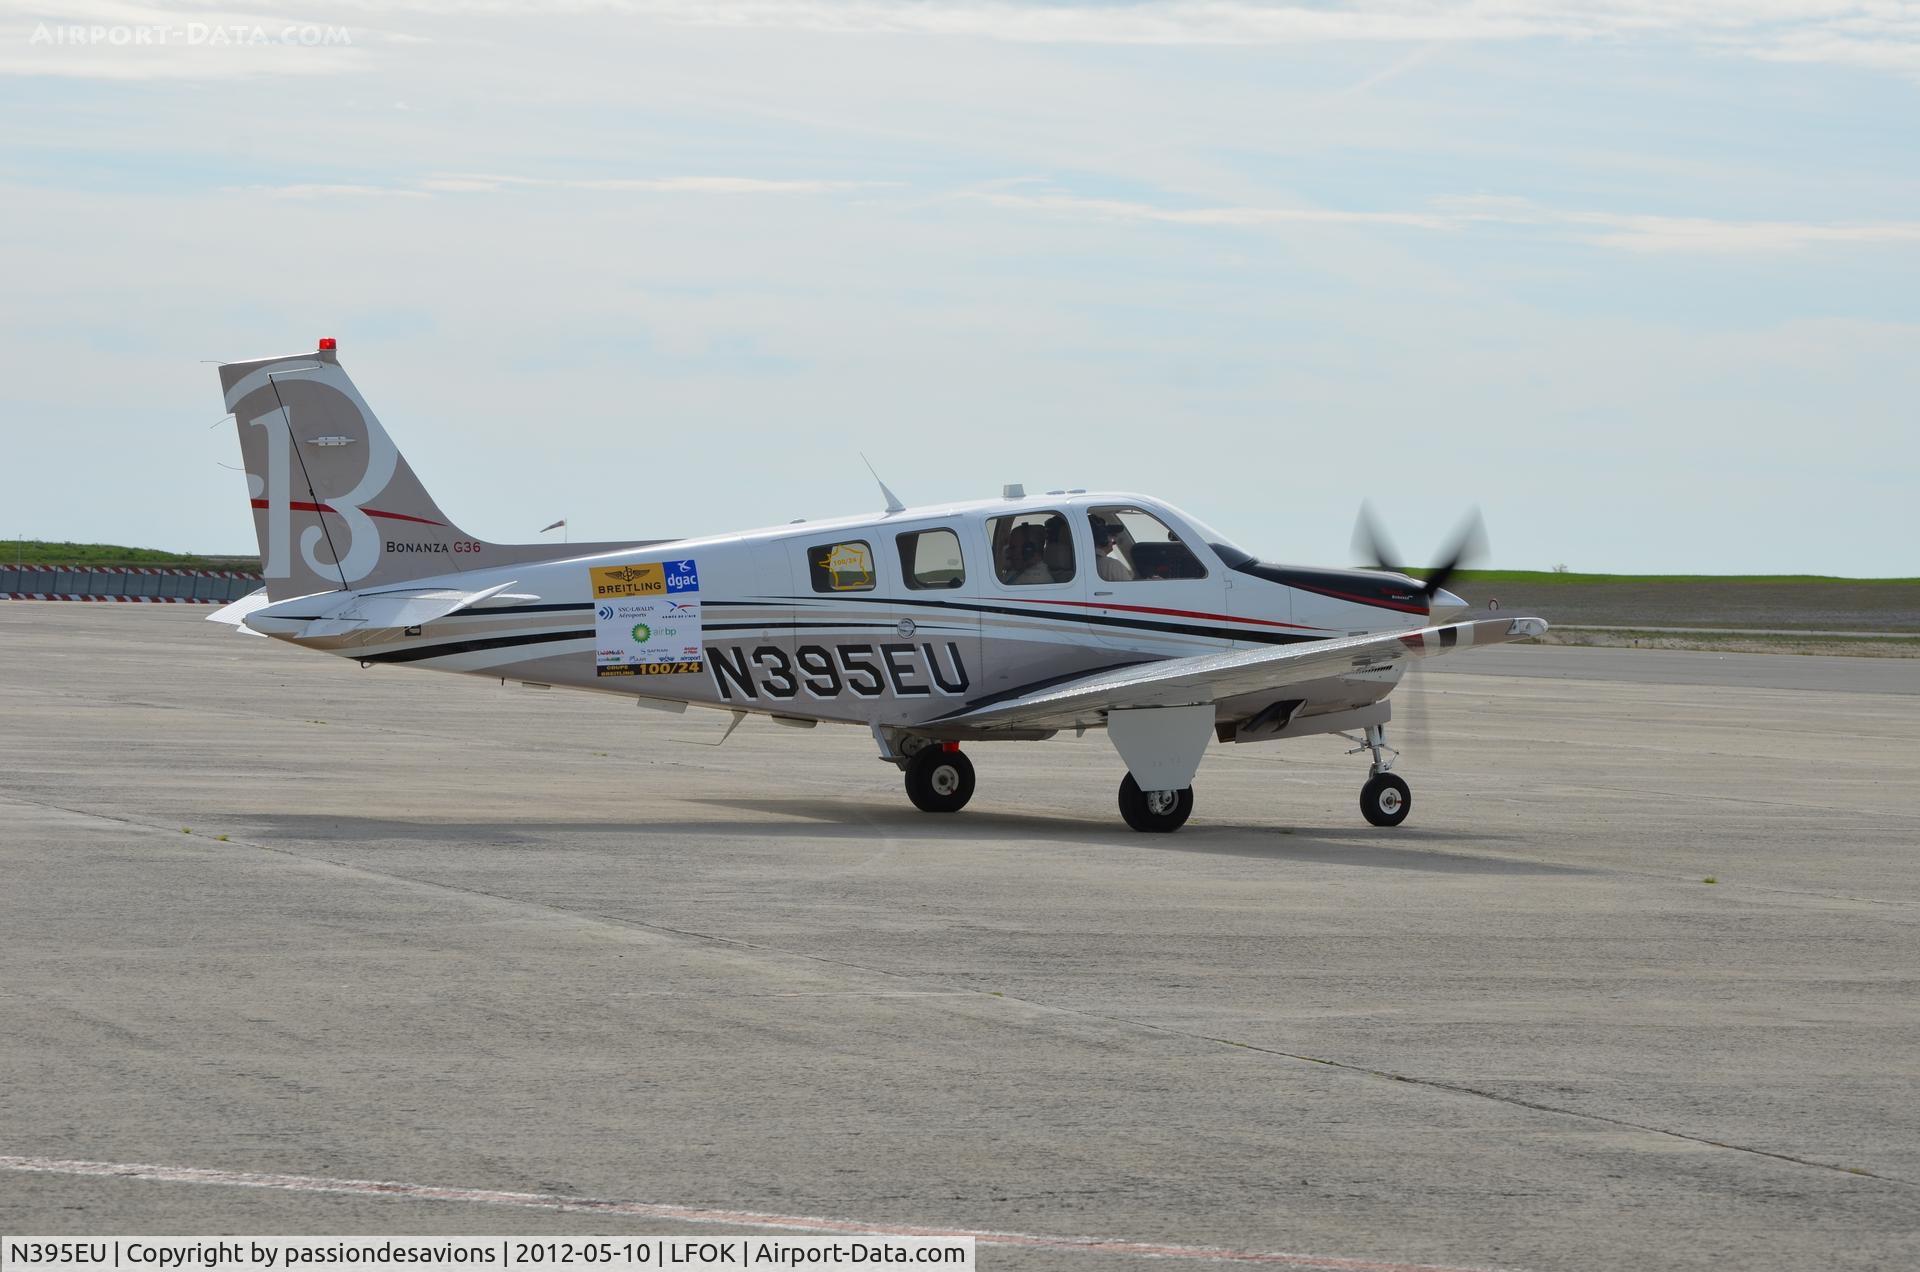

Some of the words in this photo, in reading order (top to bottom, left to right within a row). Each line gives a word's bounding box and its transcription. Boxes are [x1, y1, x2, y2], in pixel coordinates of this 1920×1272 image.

[454, 541, 481, 553] G36
[667, 573, 697, 589] dgac
[598, 582, 661, 594] BREITLING
[653, 627, 664, 636] air
[665, 627, 677, 637] bp
[639, 663, 699, 674] 100/24
[704, 642, 970, 702] N395EU
